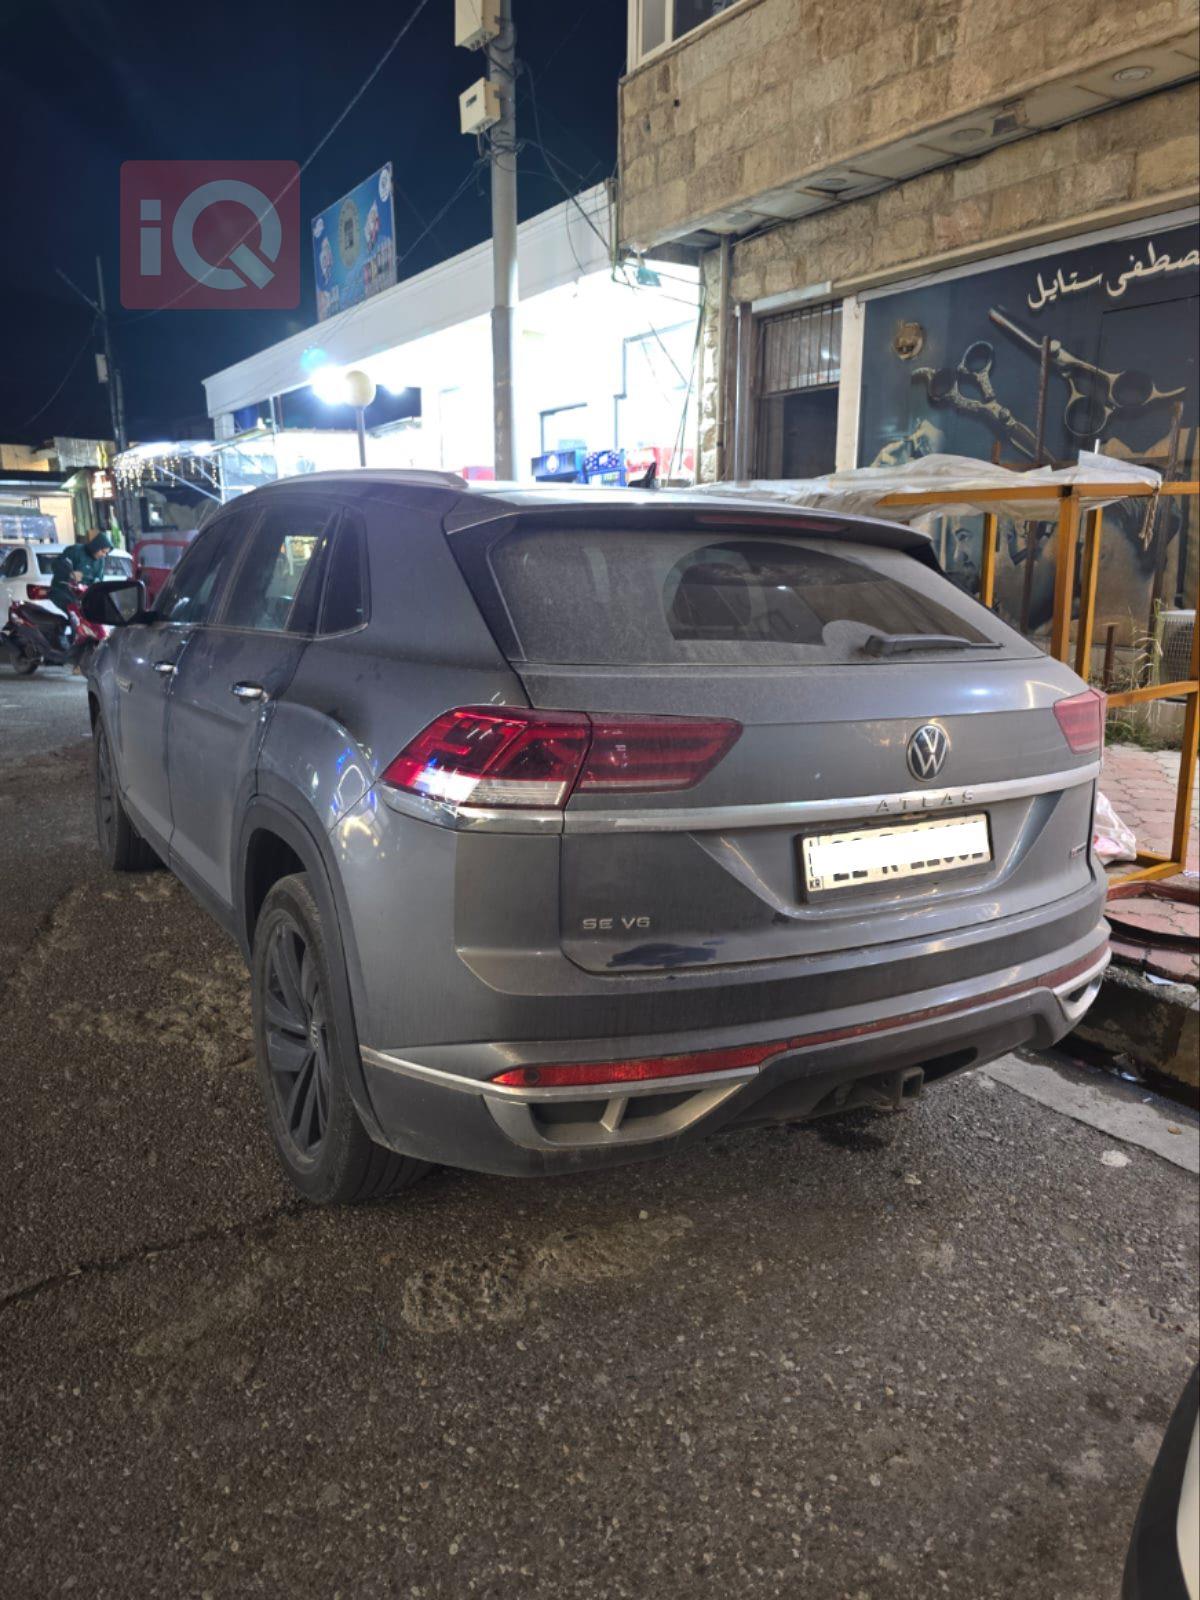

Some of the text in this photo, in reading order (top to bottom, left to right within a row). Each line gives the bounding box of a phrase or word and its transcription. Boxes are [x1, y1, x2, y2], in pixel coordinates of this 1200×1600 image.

[1027, 241, 1199, 309] صطفى ستايل
[876, 789, 974, 813] ATLAS
[582, 916, 651, 930] SE V6
